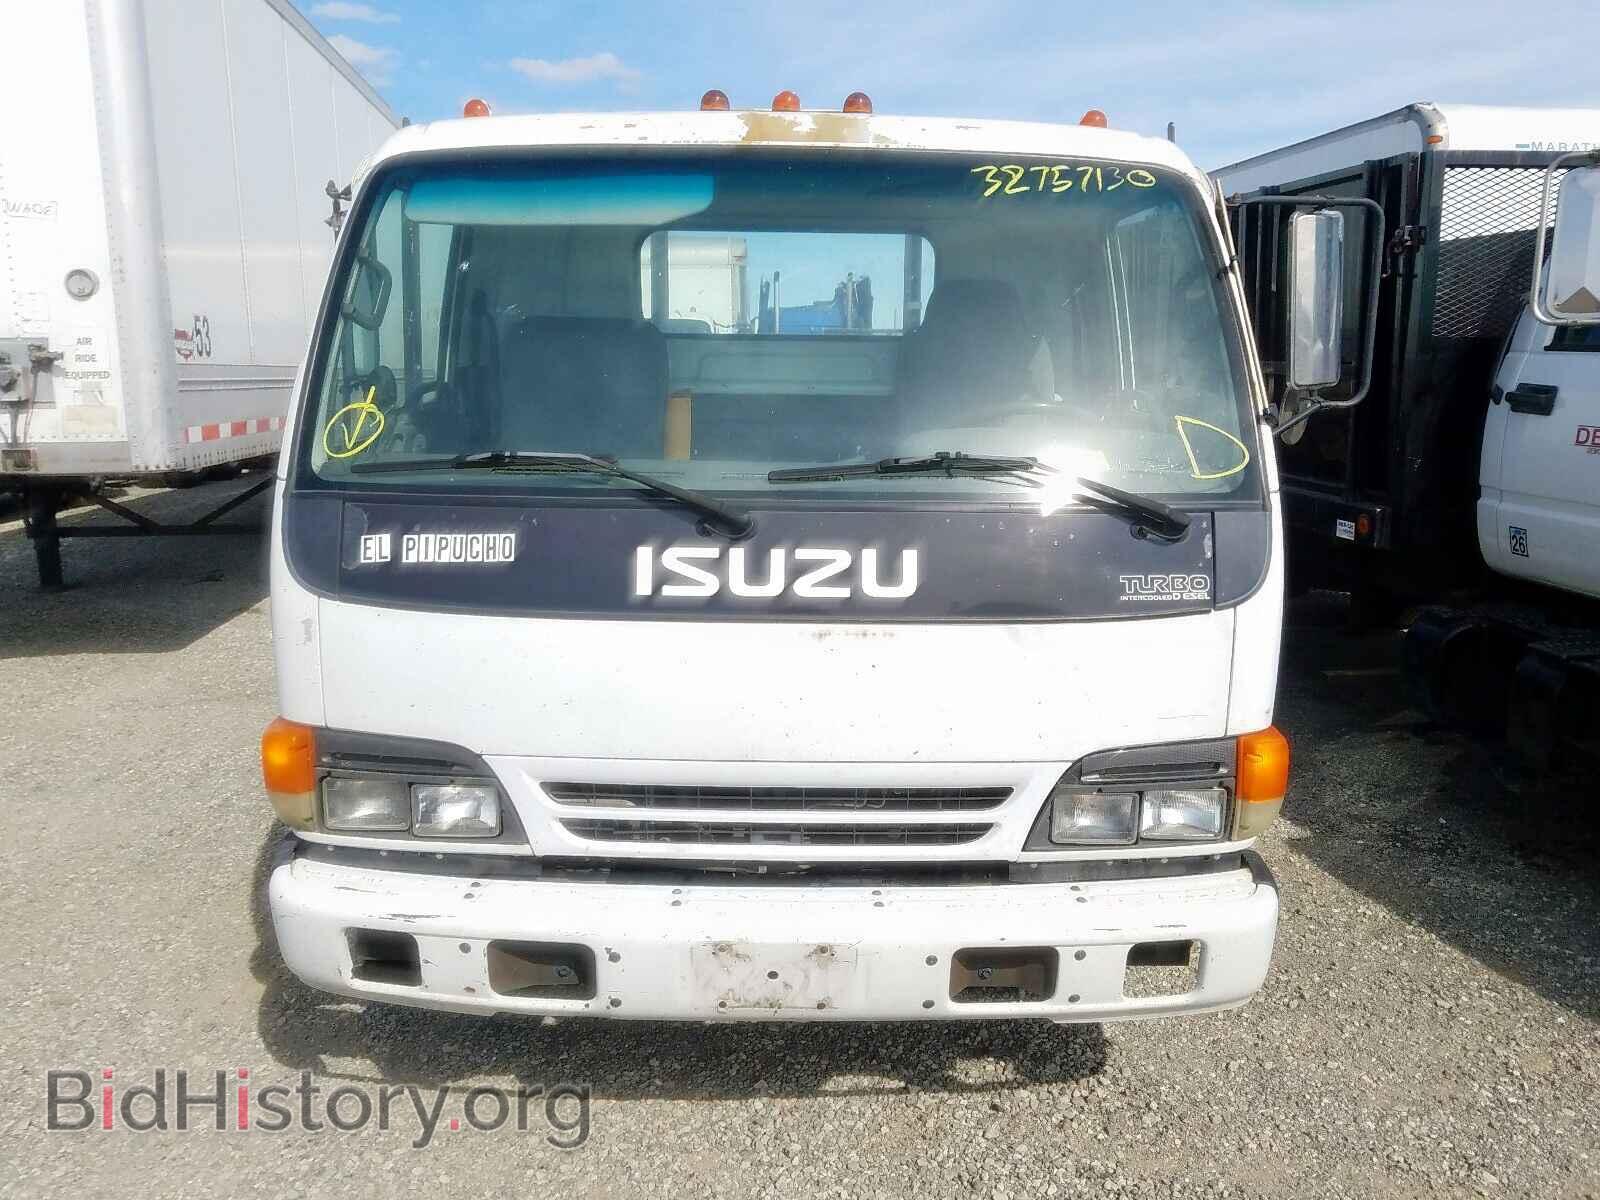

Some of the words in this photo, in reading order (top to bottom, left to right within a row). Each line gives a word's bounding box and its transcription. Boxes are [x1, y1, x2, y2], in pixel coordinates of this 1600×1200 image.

[970, 164, 1156, 197] 32757130
[76, 337, 93, 346] AIR
[75, 353, 97, 362] RIDE
[64, 370, 111, 380] EQUIPPED
[361, 534, 391, 563] EL
[402, 533, 516, 563] PIPUCHO
[1511, 534, 1526, 553] 26
[636, 546, 918, 598] ISUZU
[1120, 574, 1210, 593] TURBO
[1173, 592, 1211, 600] DESEL
